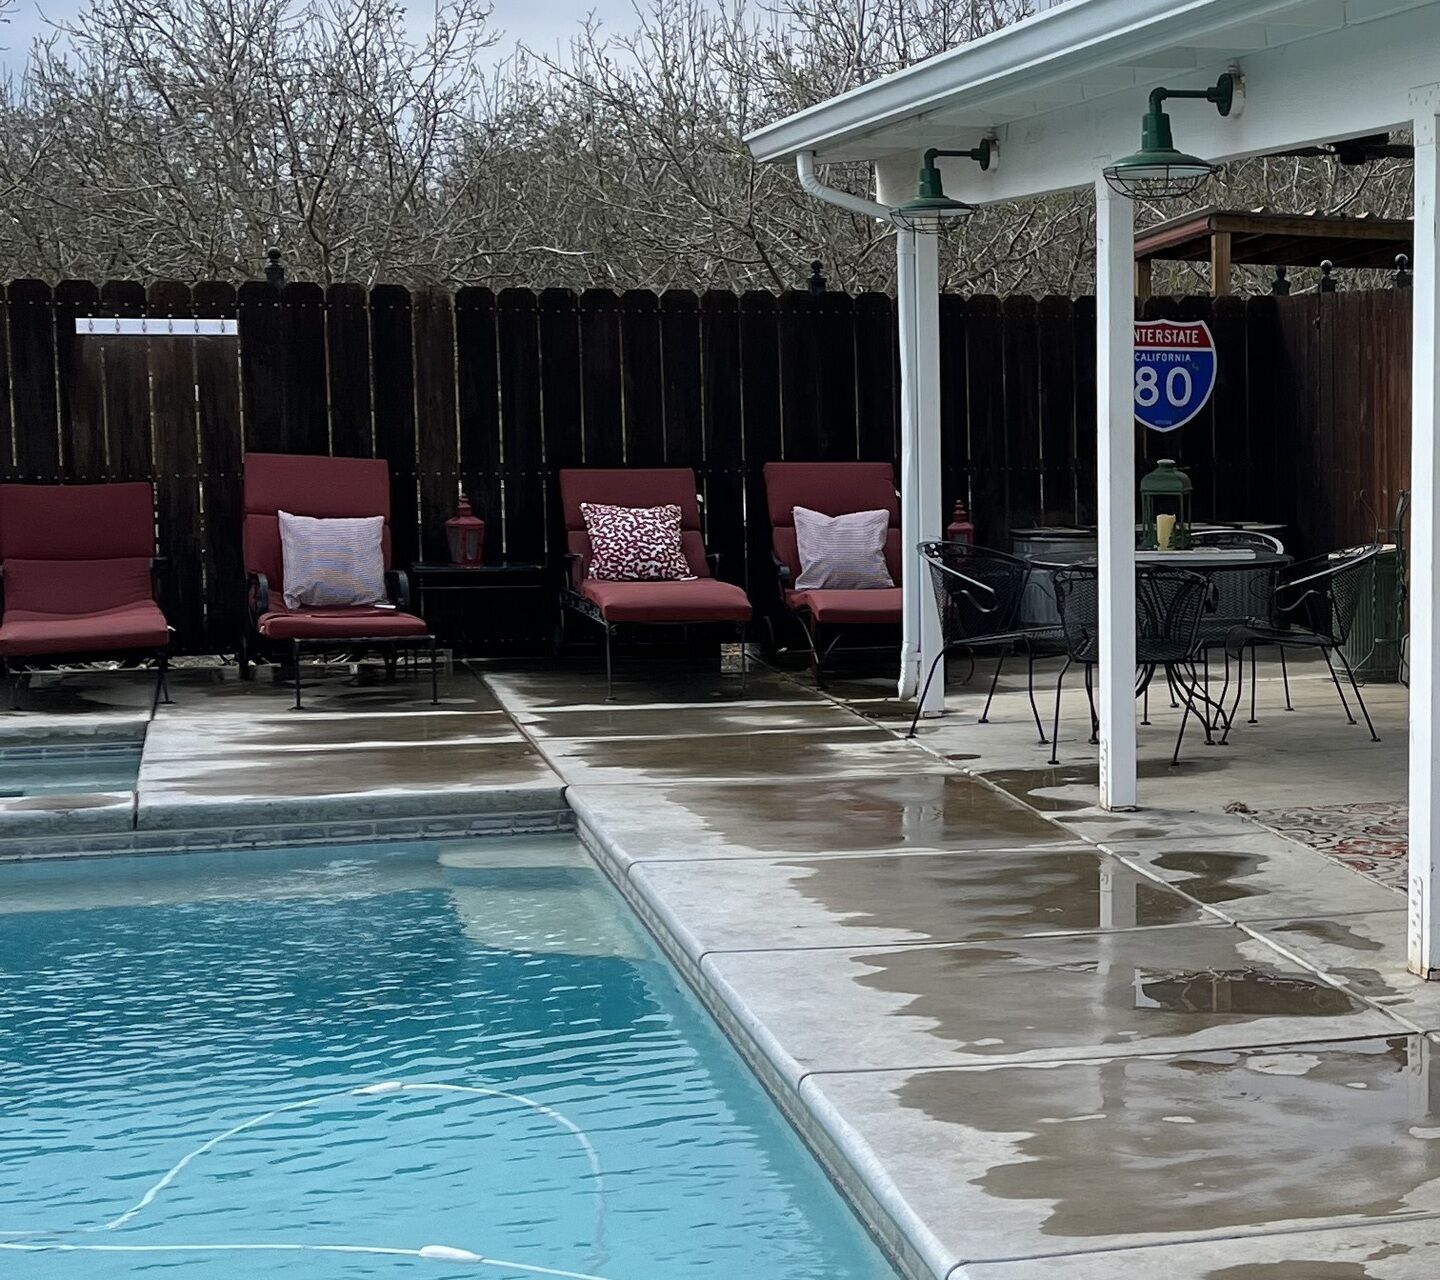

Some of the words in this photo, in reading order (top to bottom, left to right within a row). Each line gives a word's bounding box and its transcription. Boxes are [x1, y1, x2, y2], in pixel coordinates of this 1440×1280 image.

[1134, 329, 1199, 344] NTERSTATE
[1134, 352, 1192, 362] CALIFORNIA
[1134, 366, 1192, 407] 80
